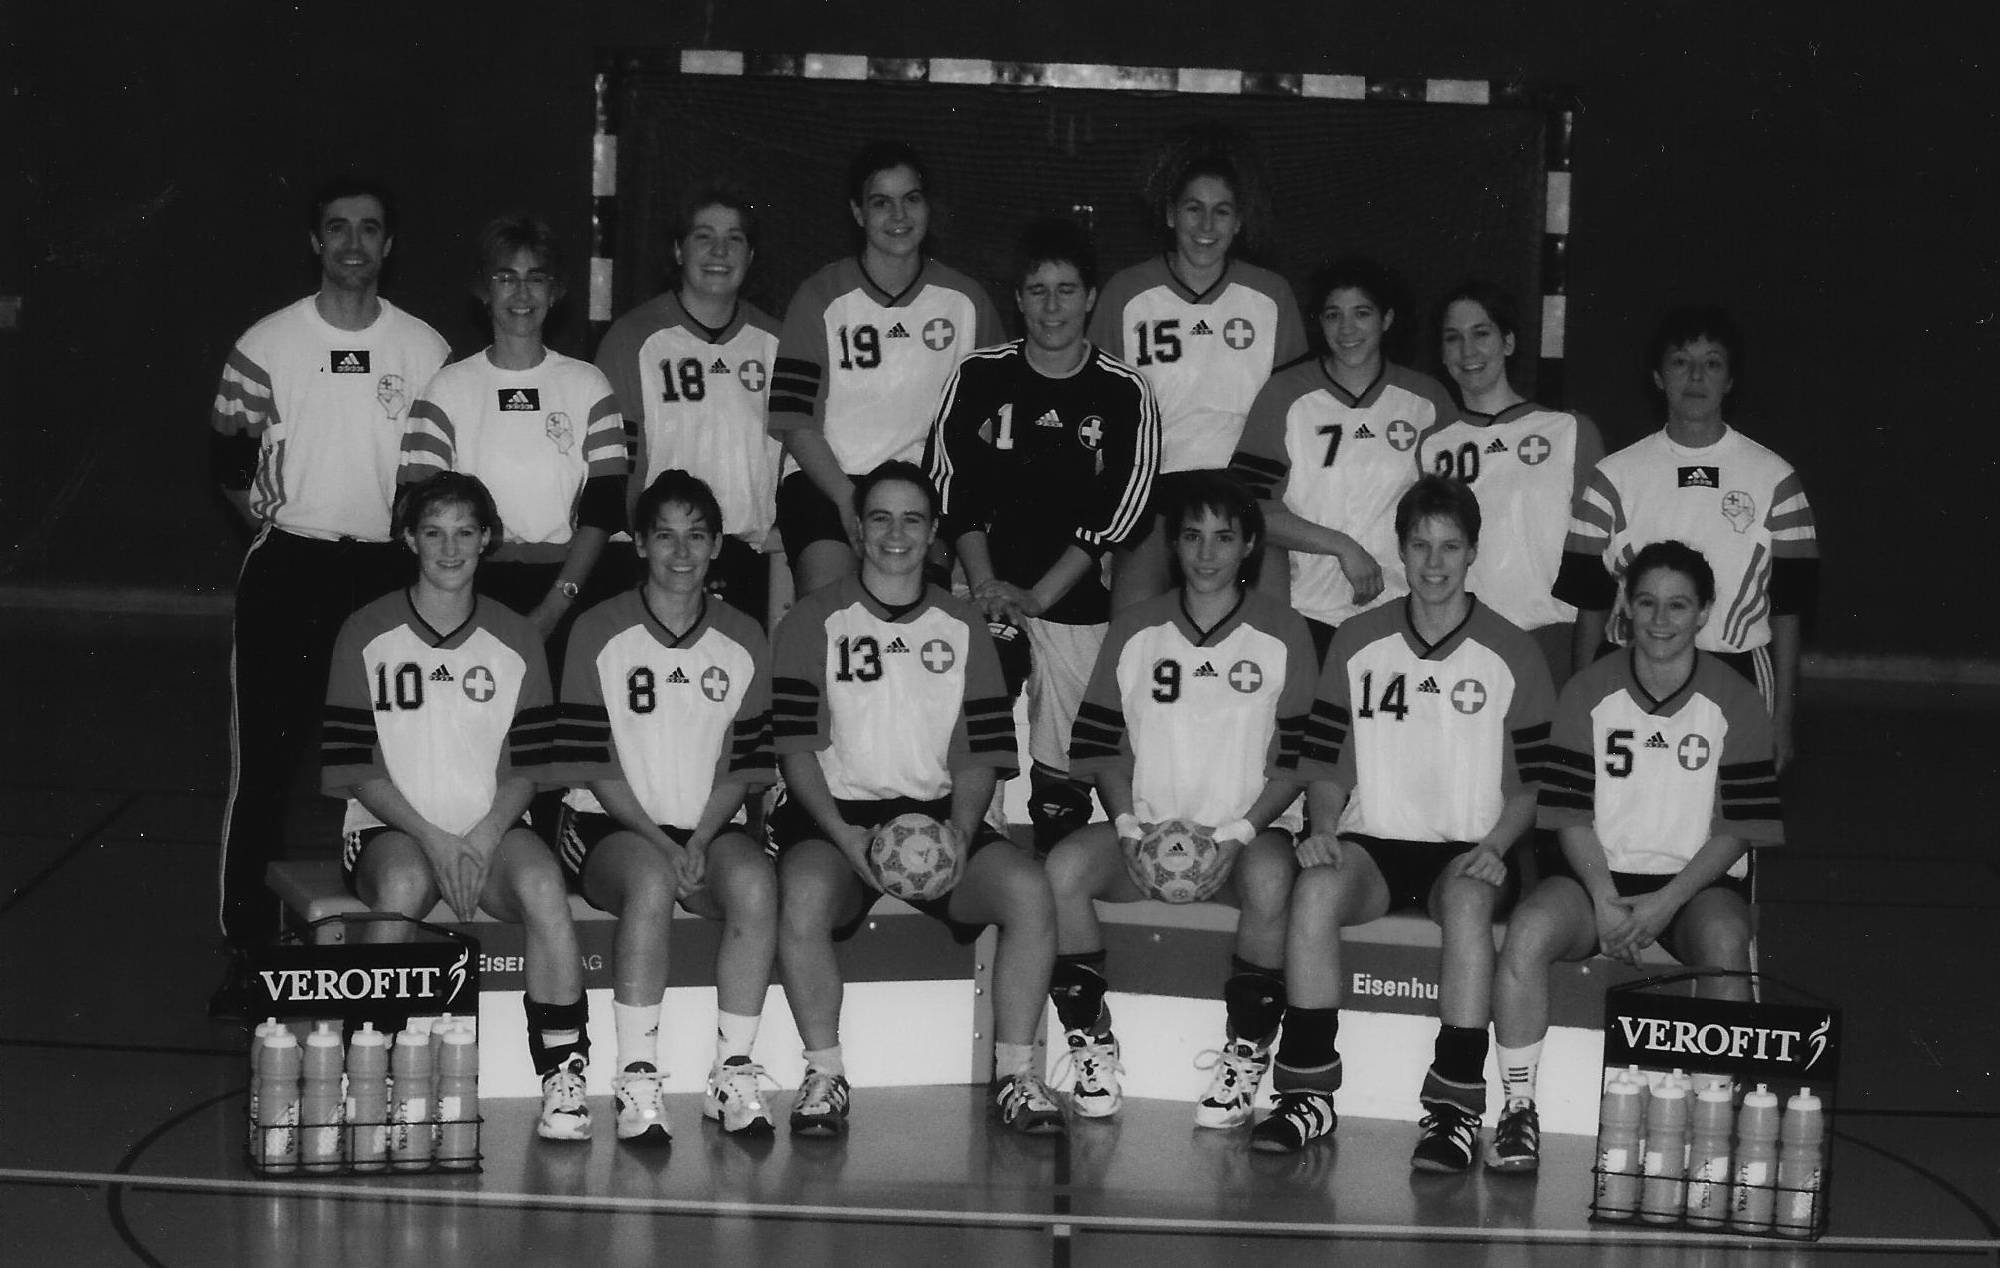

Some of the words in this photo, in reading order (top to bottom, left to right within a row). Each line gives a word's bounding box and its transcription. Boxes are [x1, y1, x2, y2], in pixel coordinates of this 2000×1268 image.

[838, 324, 881, 370] 19
[1133, 319, 1182, 367] 15
[660, 358, 705, 402] 18
[996, 403, 1014, 450] 1
[1316, 424, 1343, 468] 7
[836, 635, 882, 682] 13
[1152, 659, 1181, 703] 9
[375, 662, 423, 711] 10
[627, 666, 655, 714] 8
[1359, 670, 1408, 720] 14
[1605, 729, 1634, 778] 5
[259, 967, 440, 1001] VEROFIT
[1353, 972, 1439, 1000] Eisenhu
[1617, 1015, 1801, 1062] VEROFIT
